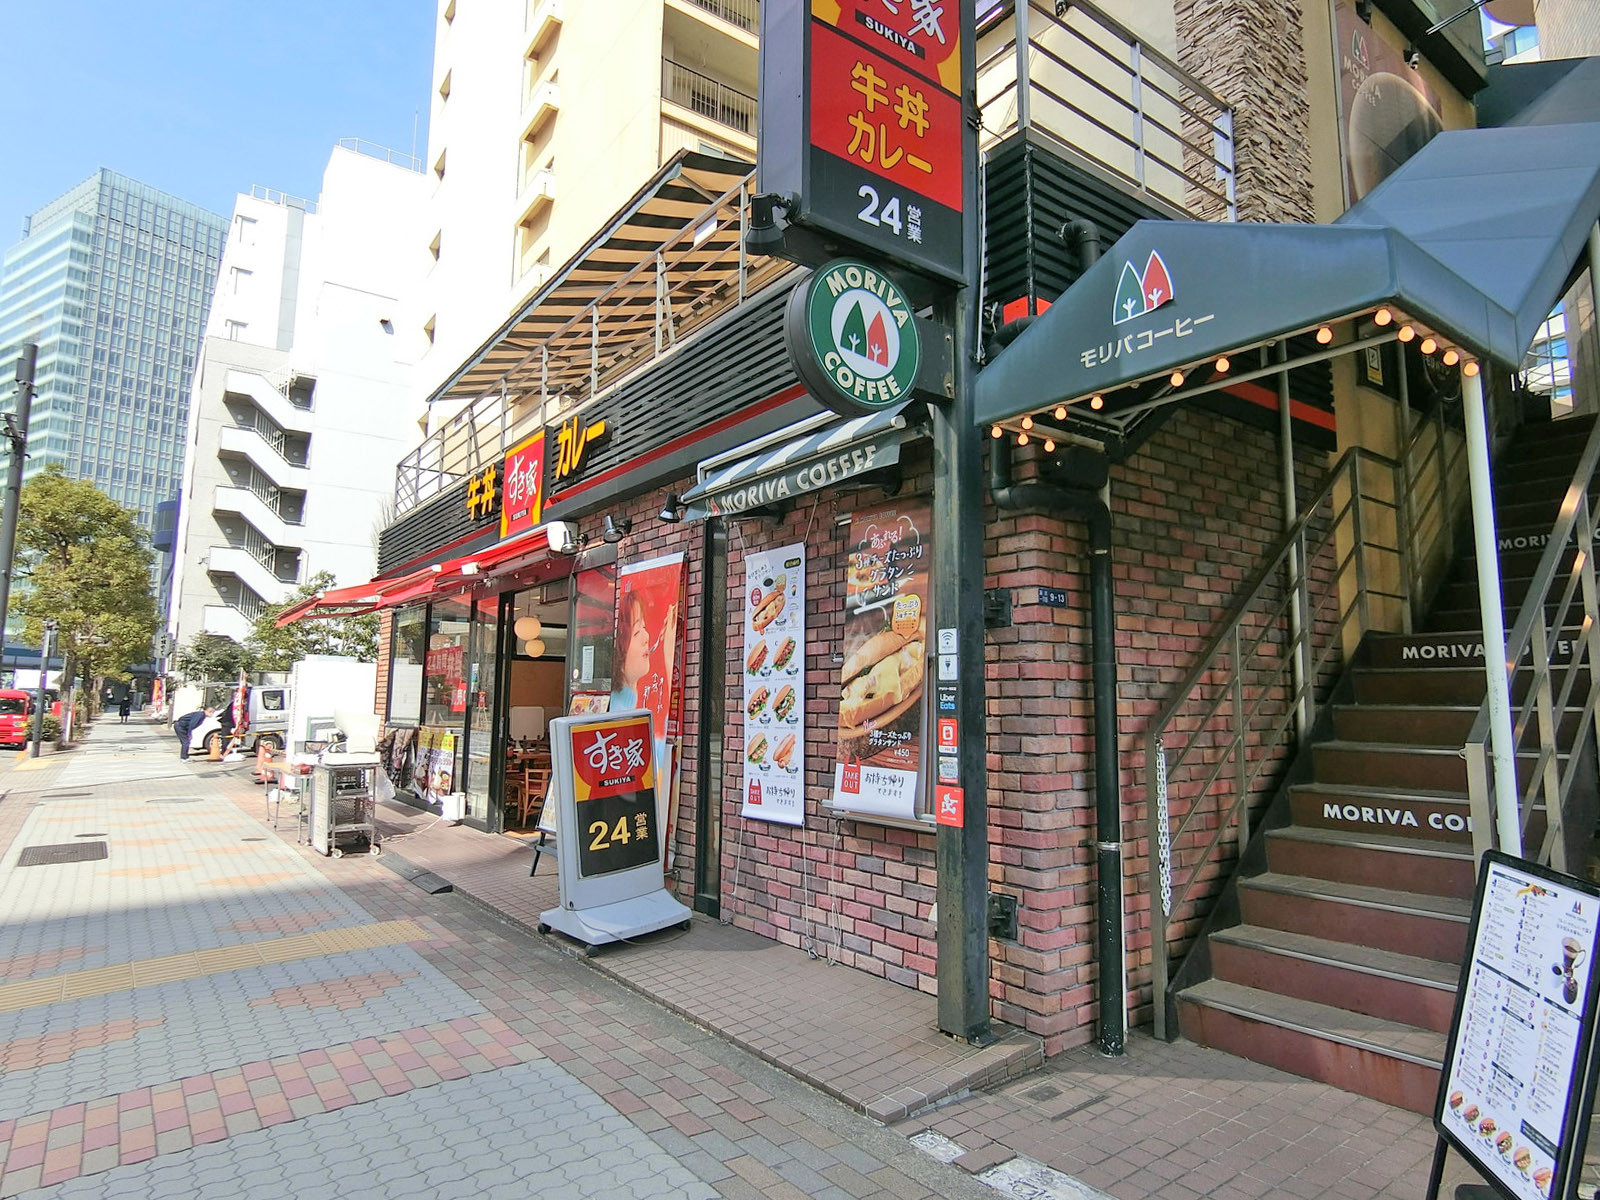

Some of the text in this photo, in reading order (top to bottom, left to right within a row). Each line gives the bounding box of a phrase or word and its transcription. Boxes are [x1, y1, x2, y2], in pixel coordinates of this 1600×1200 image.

[865, 16, 916, 54] SUKIYA
[851, 60, 930, 138] 牛丼
[847, 110, 933, 174] カレー
[857, 184, 922, 245] 24 営業
[826, 266, 909, 329] MORIVA
[1080, 314, 1215, 369] モリバコーヒー
[824, 351, 901, 401] COFFEE
[555, 415, 607, 480] カレー
[466, 463, 497, 521] 牛丼
[507, 454, 539, 506] すき家
[721, 444, 877, 515] MORIVA COFFEE
[870, 565, 905, 582] グラタン
[872, 581, 899, 598] サンド
[1402, 644, 1487, 660] MORIVA
[940, 693, 956, 702] Uber
[940, 702, 956, 710] Eats
[583, 730, 645, 775] すき家
[604, 776, 631, 787] SUKIYA
[843, 780, 859, 789] OUT
[844, 770, 859, 780] TAKE
[864, 772, 905, 788] お持ち帰り
[588, 811, 649, 852] 24 営業
[1323, 803, 1419, 828] MORIVA
